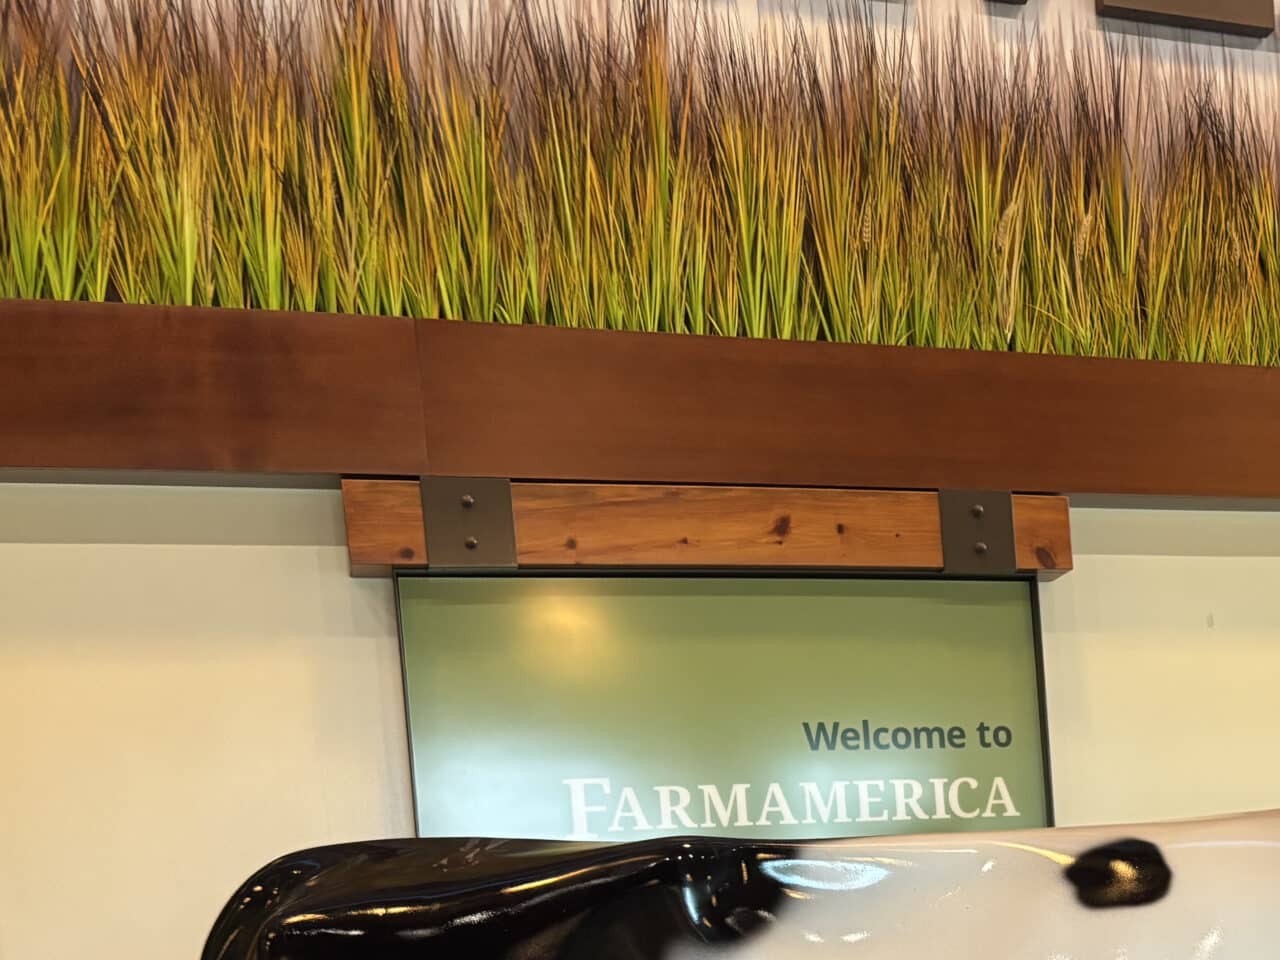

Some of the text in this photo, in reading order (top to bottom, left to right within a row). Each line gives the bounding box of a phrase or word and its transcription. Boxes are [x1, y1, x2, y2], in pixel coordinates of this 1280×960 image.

[802, 720, 1013, 751] Welcome to
[562, 776, 1021, 842] FARMAMERICA
